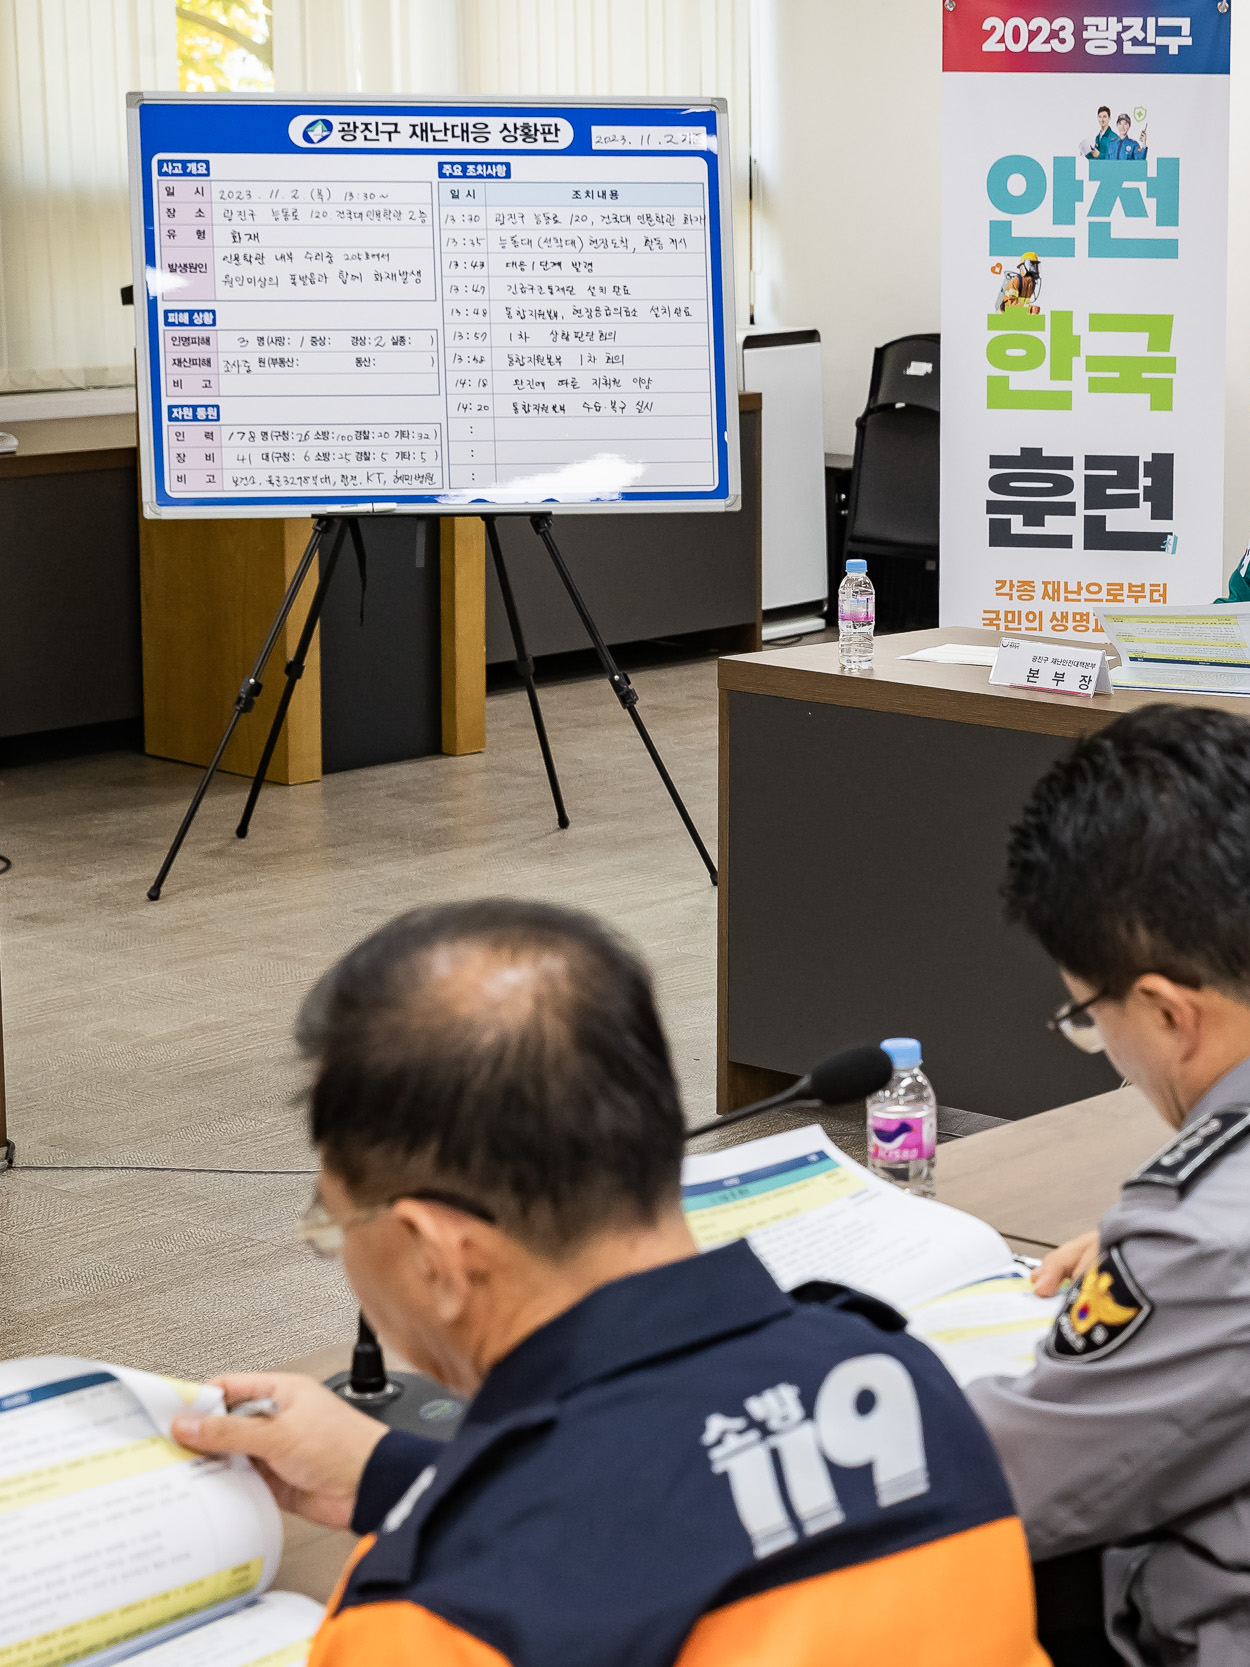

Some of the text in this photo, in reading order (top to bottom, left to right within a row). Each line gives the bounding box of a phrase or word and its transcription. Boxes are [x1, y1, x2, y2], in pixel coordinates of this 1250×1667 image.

[981, 16, 1193, 56] 2023 광진구
[337, 121, 561, 144] 광진구 재난대응 상황판
[162, 162, 208, 175] 사고 개요
[442, 164, 507, 178] 주요 조치사항
[986, 154, 1180, 260] 안전
[636, 212, 676, 227] 인문학관
[168, 261, 208, 274] 발생원인
[167, 310, 214, 325] 피해 상황
[171, 335, 211, 347] 인명피해
[172, 356, 213, 369] 재산피해
[986, 306, 1177, 412] 한국
[171, 407, 217, 421] 자원 동원
[986, 447, 1175, 551] 훈련
[994, 579, 1168, 604] 각종 재난으로부터
[982, 609, 1043, 632] 국민의
[1031, 655, 1049, 665] 광진구
[710, 1352, 932, 1561] 119
